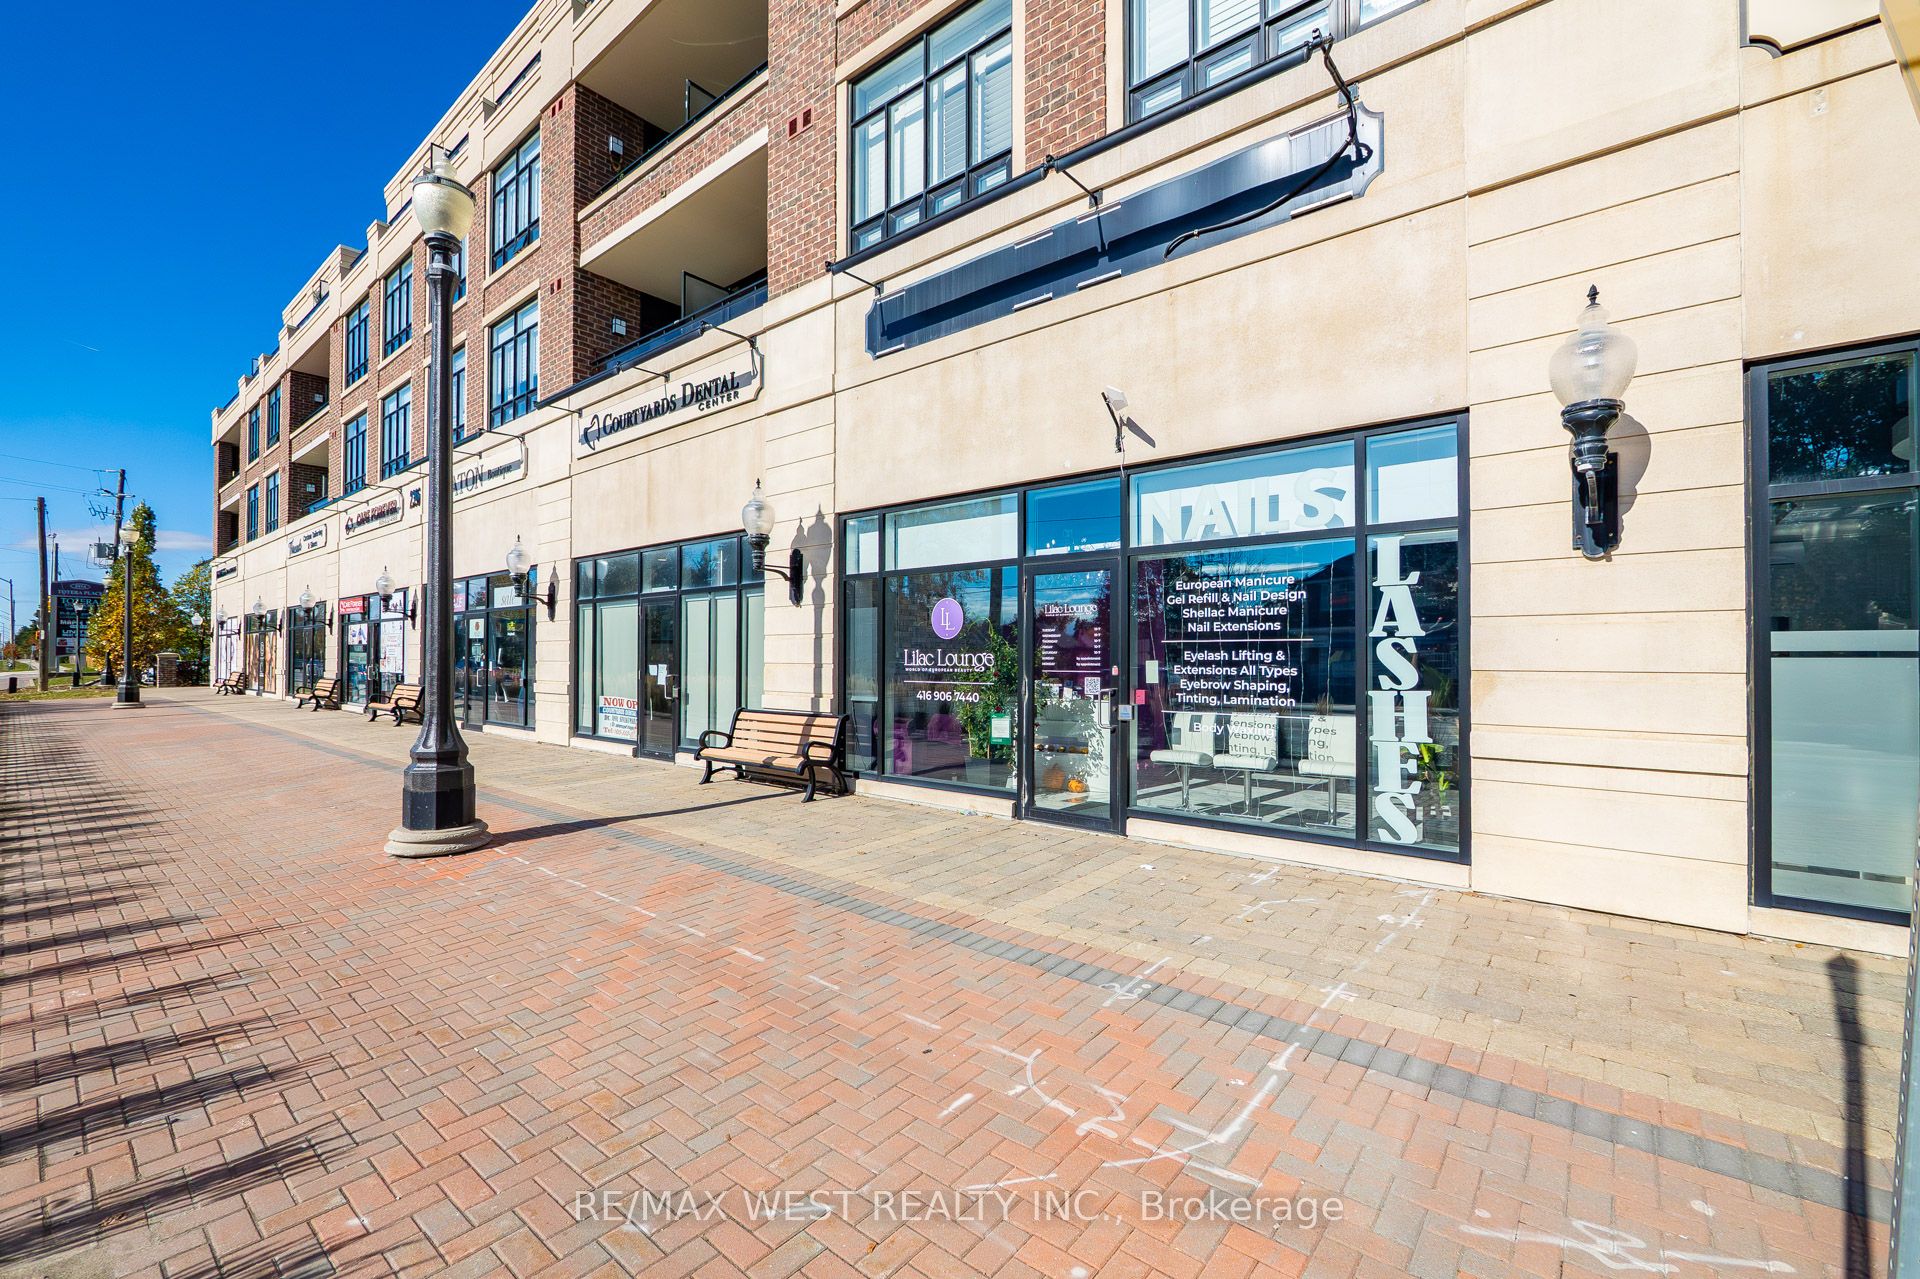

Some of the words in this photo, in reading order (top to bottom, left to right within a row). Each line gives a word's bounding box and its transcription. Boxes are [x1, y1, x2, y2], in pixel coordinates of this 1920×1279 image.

[603, 393, 677, 435] COURTYARDS
[681, 371, 740, 408] DENTAL
[697, 390, 740, 412] CENTER
[1143, 468, 1338, 544] NAILS
[1175, 579, 1232, 591] European
[1235, 575, 1295, 587] Manicure
[1166, 594, 1185, 605] Gel
[1188, 592, 1218, 604] Refill
[1221, 592, 1230, 602] &
[1233, 591, 1257, 602] Nail
[1260, 589, 1307, 601] Design
[1064, 604, 1098, 615] Lounge
[1182, 607, 1225, 618] Shellac
[1228, 606, 1288, 617] Manicure
[1187, 622, 1210, 632] Nail
[1213, 620, 1281, 632] Extensions
[903, 649, 935, 667] Lilac
[936, 649, 995, 673] Lounge
[1184, 650, 1229, 663] Eyelash
[1231, 650, 1273, 663] Lifting
[1275, 650, 1286, 661] &
[1173, 665, 1238, 675] Extensions
[1240, 665, 1256, 676] All
[1259, 666, 1298, 678] Types
[1180, 679, 1232, 691] Eyebrow
[1233, 680, 1290, 693] Shaping,
[1367, 535, 1433, 844] LASHES
[603, 697, 625, 708] NOW
[916, 690, 932, 701] 416
[933, 691, 952, 701] 906
[953, 692, 979, 702] 7440
[1175, 692, 1221, 706] Tinting,
[1223, 694, 1296, 707] Lamination
[1193, 722, 1224, 734] Body
[1226, 722, 1276, 737] Waxing
